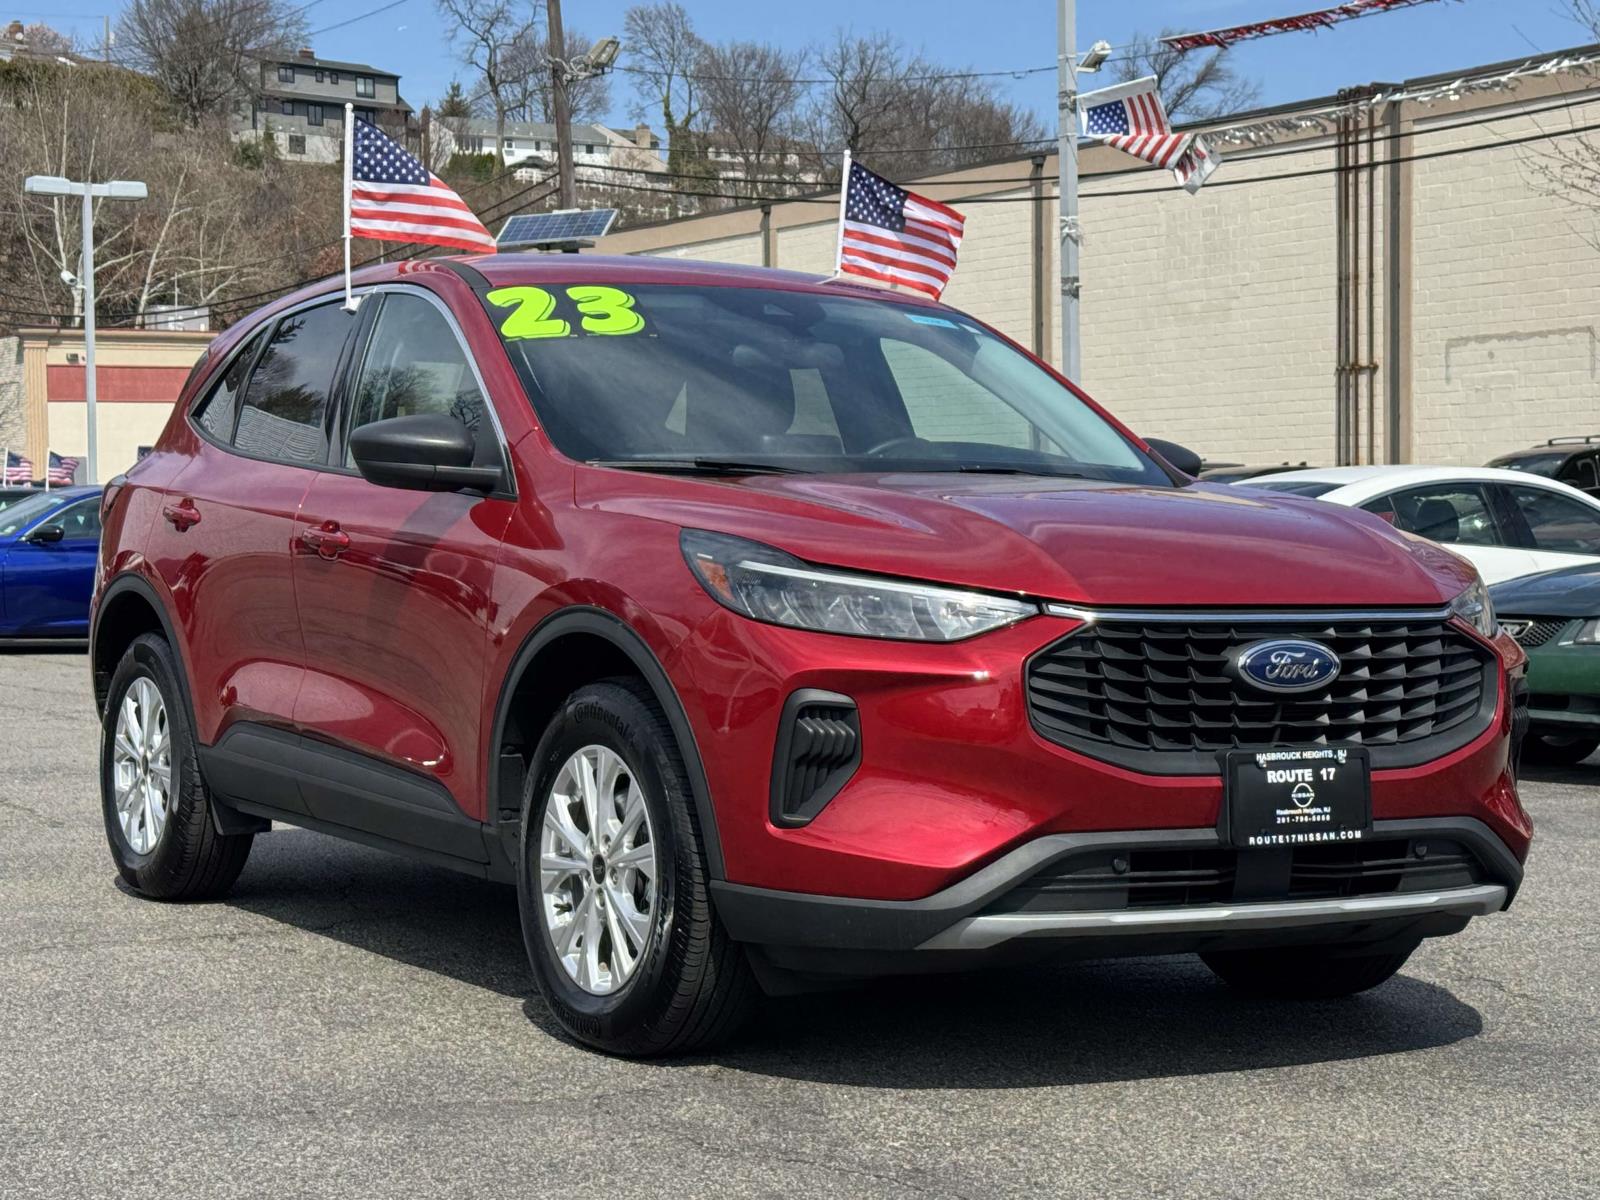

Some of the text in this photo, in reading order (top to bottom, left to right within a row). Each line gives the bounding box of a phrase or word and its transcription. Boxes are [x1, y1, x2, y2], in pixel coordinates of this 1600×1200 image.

[486, 286, 645, 339] 23
[1265, 650, 1319, 679] Ford
[1256, 751, 1301, 762] HASBROUCK
[1267, 768, 1336, 783] ROUTE 17
[1249, 830, 1362, 846] ROUTE17NISSAN.COM
